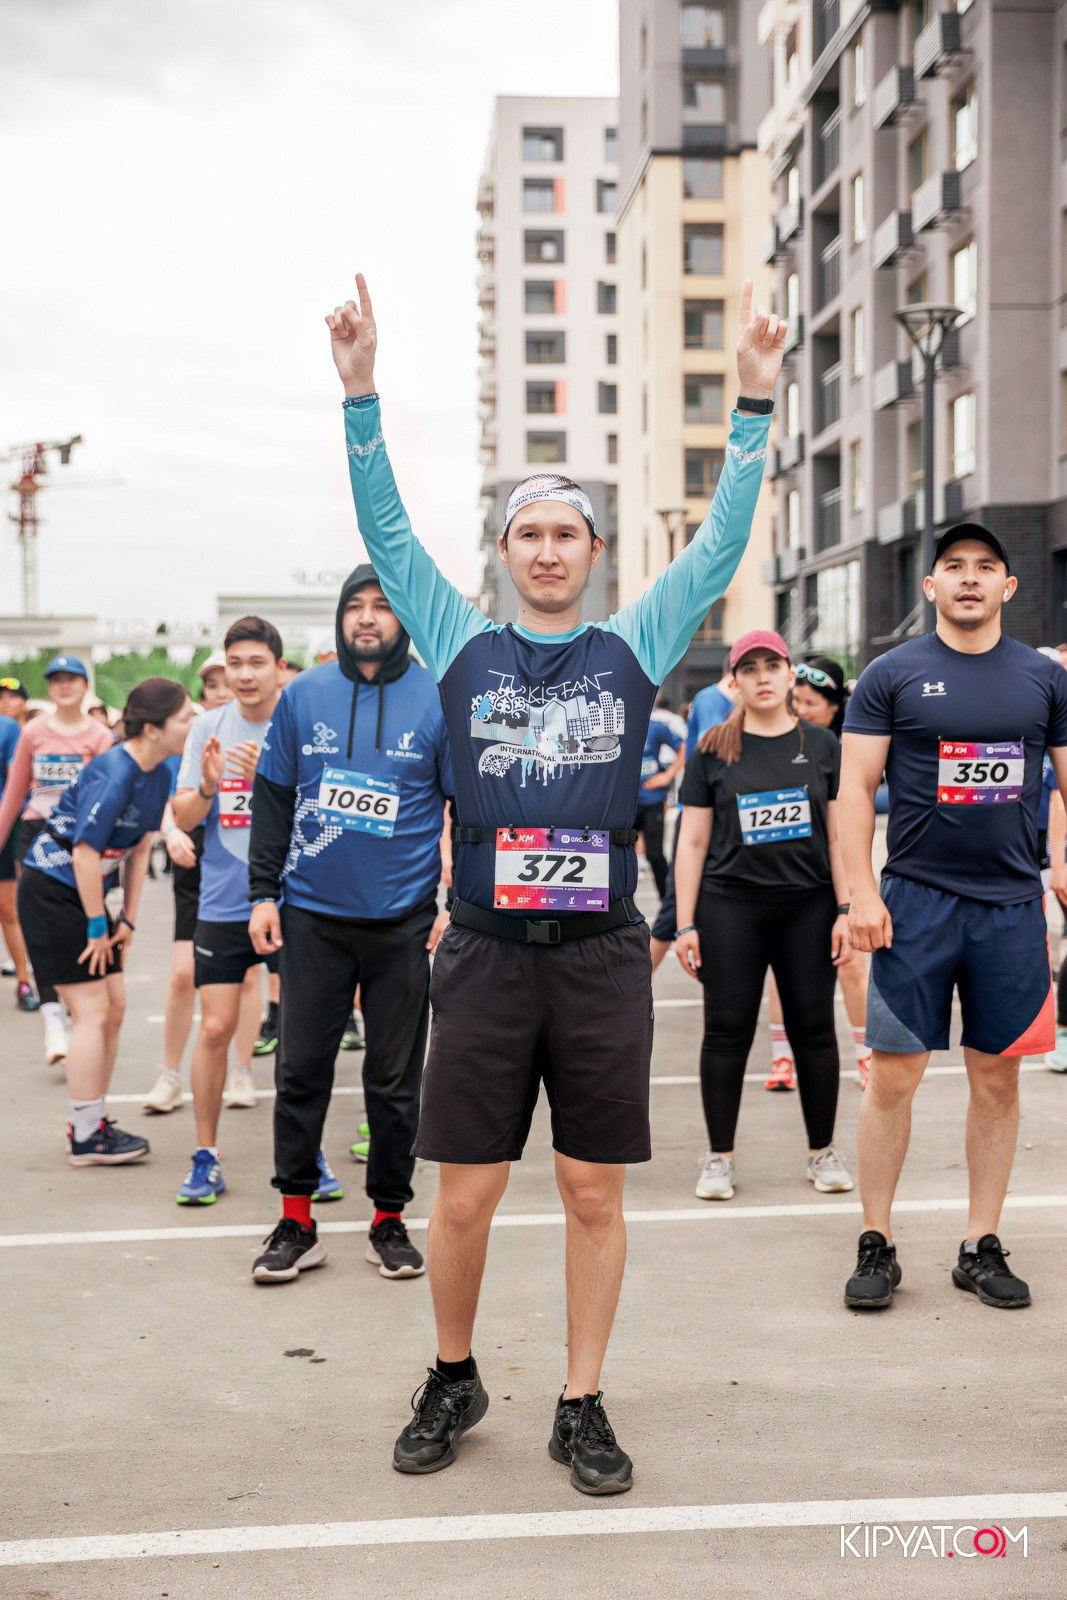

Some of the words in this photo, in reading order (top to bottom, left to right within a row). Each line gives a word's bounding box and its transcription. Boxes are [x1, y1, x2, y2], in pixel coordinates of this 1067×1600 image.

[500, 745, 556, 762] INTERNATIONAL
[604, 750, 618, 760] 2021
[943, 745, 953, 754] 10
[955, 746, 967, 754] KM
[953, 762, 1009, 784] 350
[233, 796, 253, 811] 2
[327, 788, 391, 815] 1066
[750, 805, 801, 828] 1242
[518, 835, 535, 843] KM
[517, 854, 587, 883] 372
